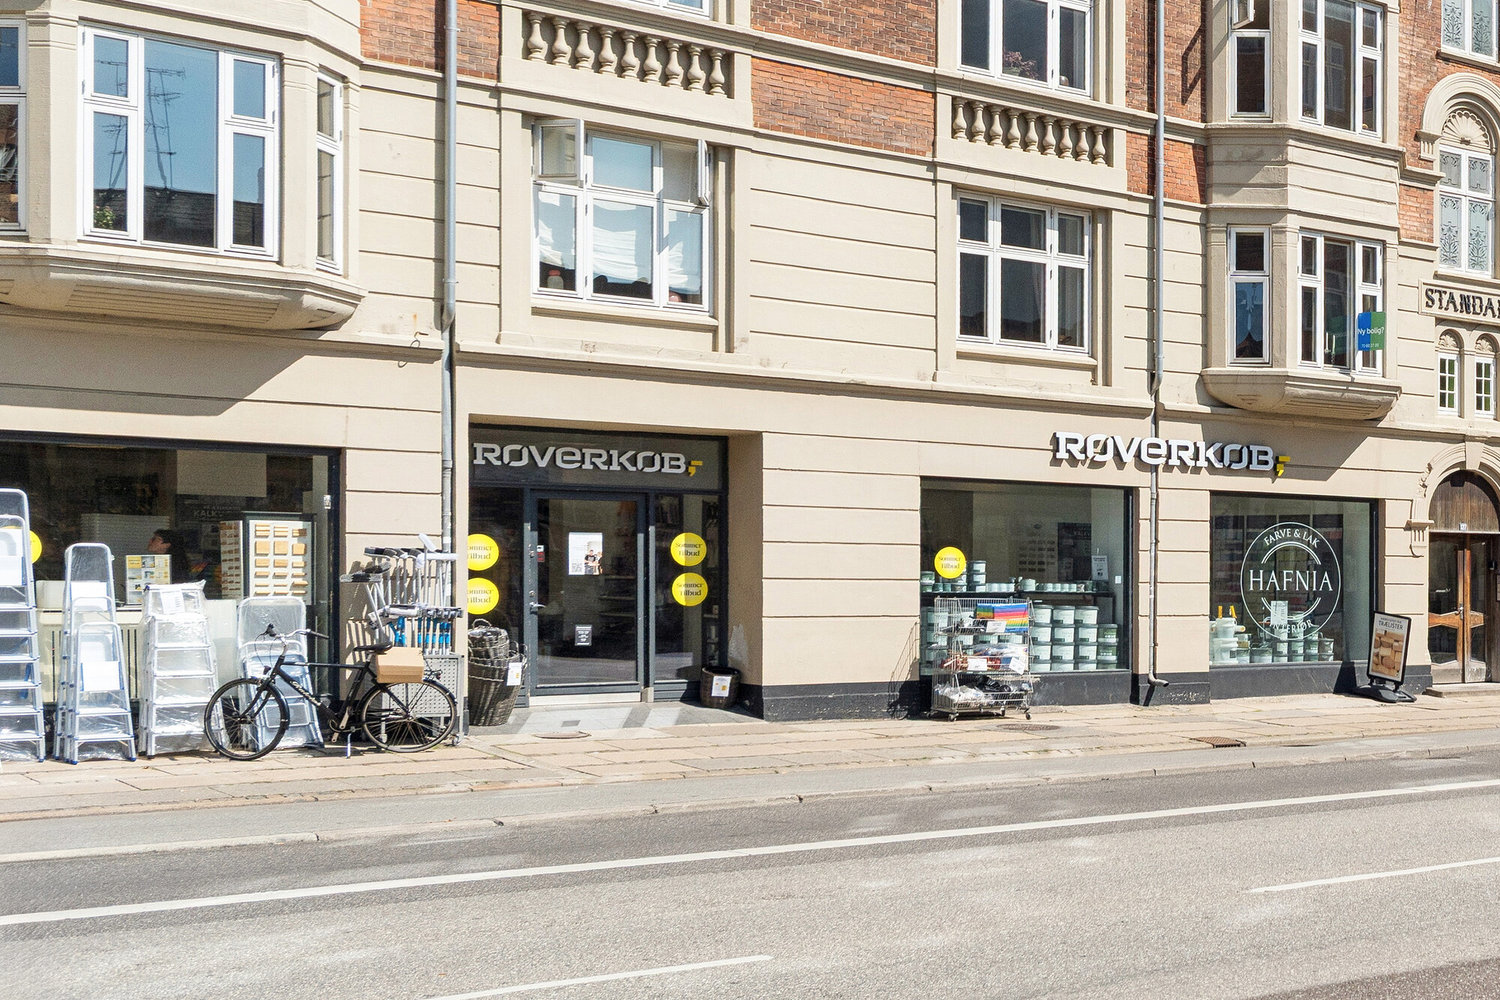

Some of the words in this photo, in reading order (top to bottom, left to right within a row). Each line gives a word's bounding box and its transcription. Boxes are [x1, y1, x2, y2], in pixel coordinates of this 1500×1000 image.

[1357, 327, 1366, 336] Ny
[1366, 326, 1385, 335] bolig?
[1263, 528, 1292, 546] FARVE
[1293, 528, 1302, 538] &
[1302, 531, 1320, 548] LAK
[1249, 569, 1333, 592] HAFNIA
